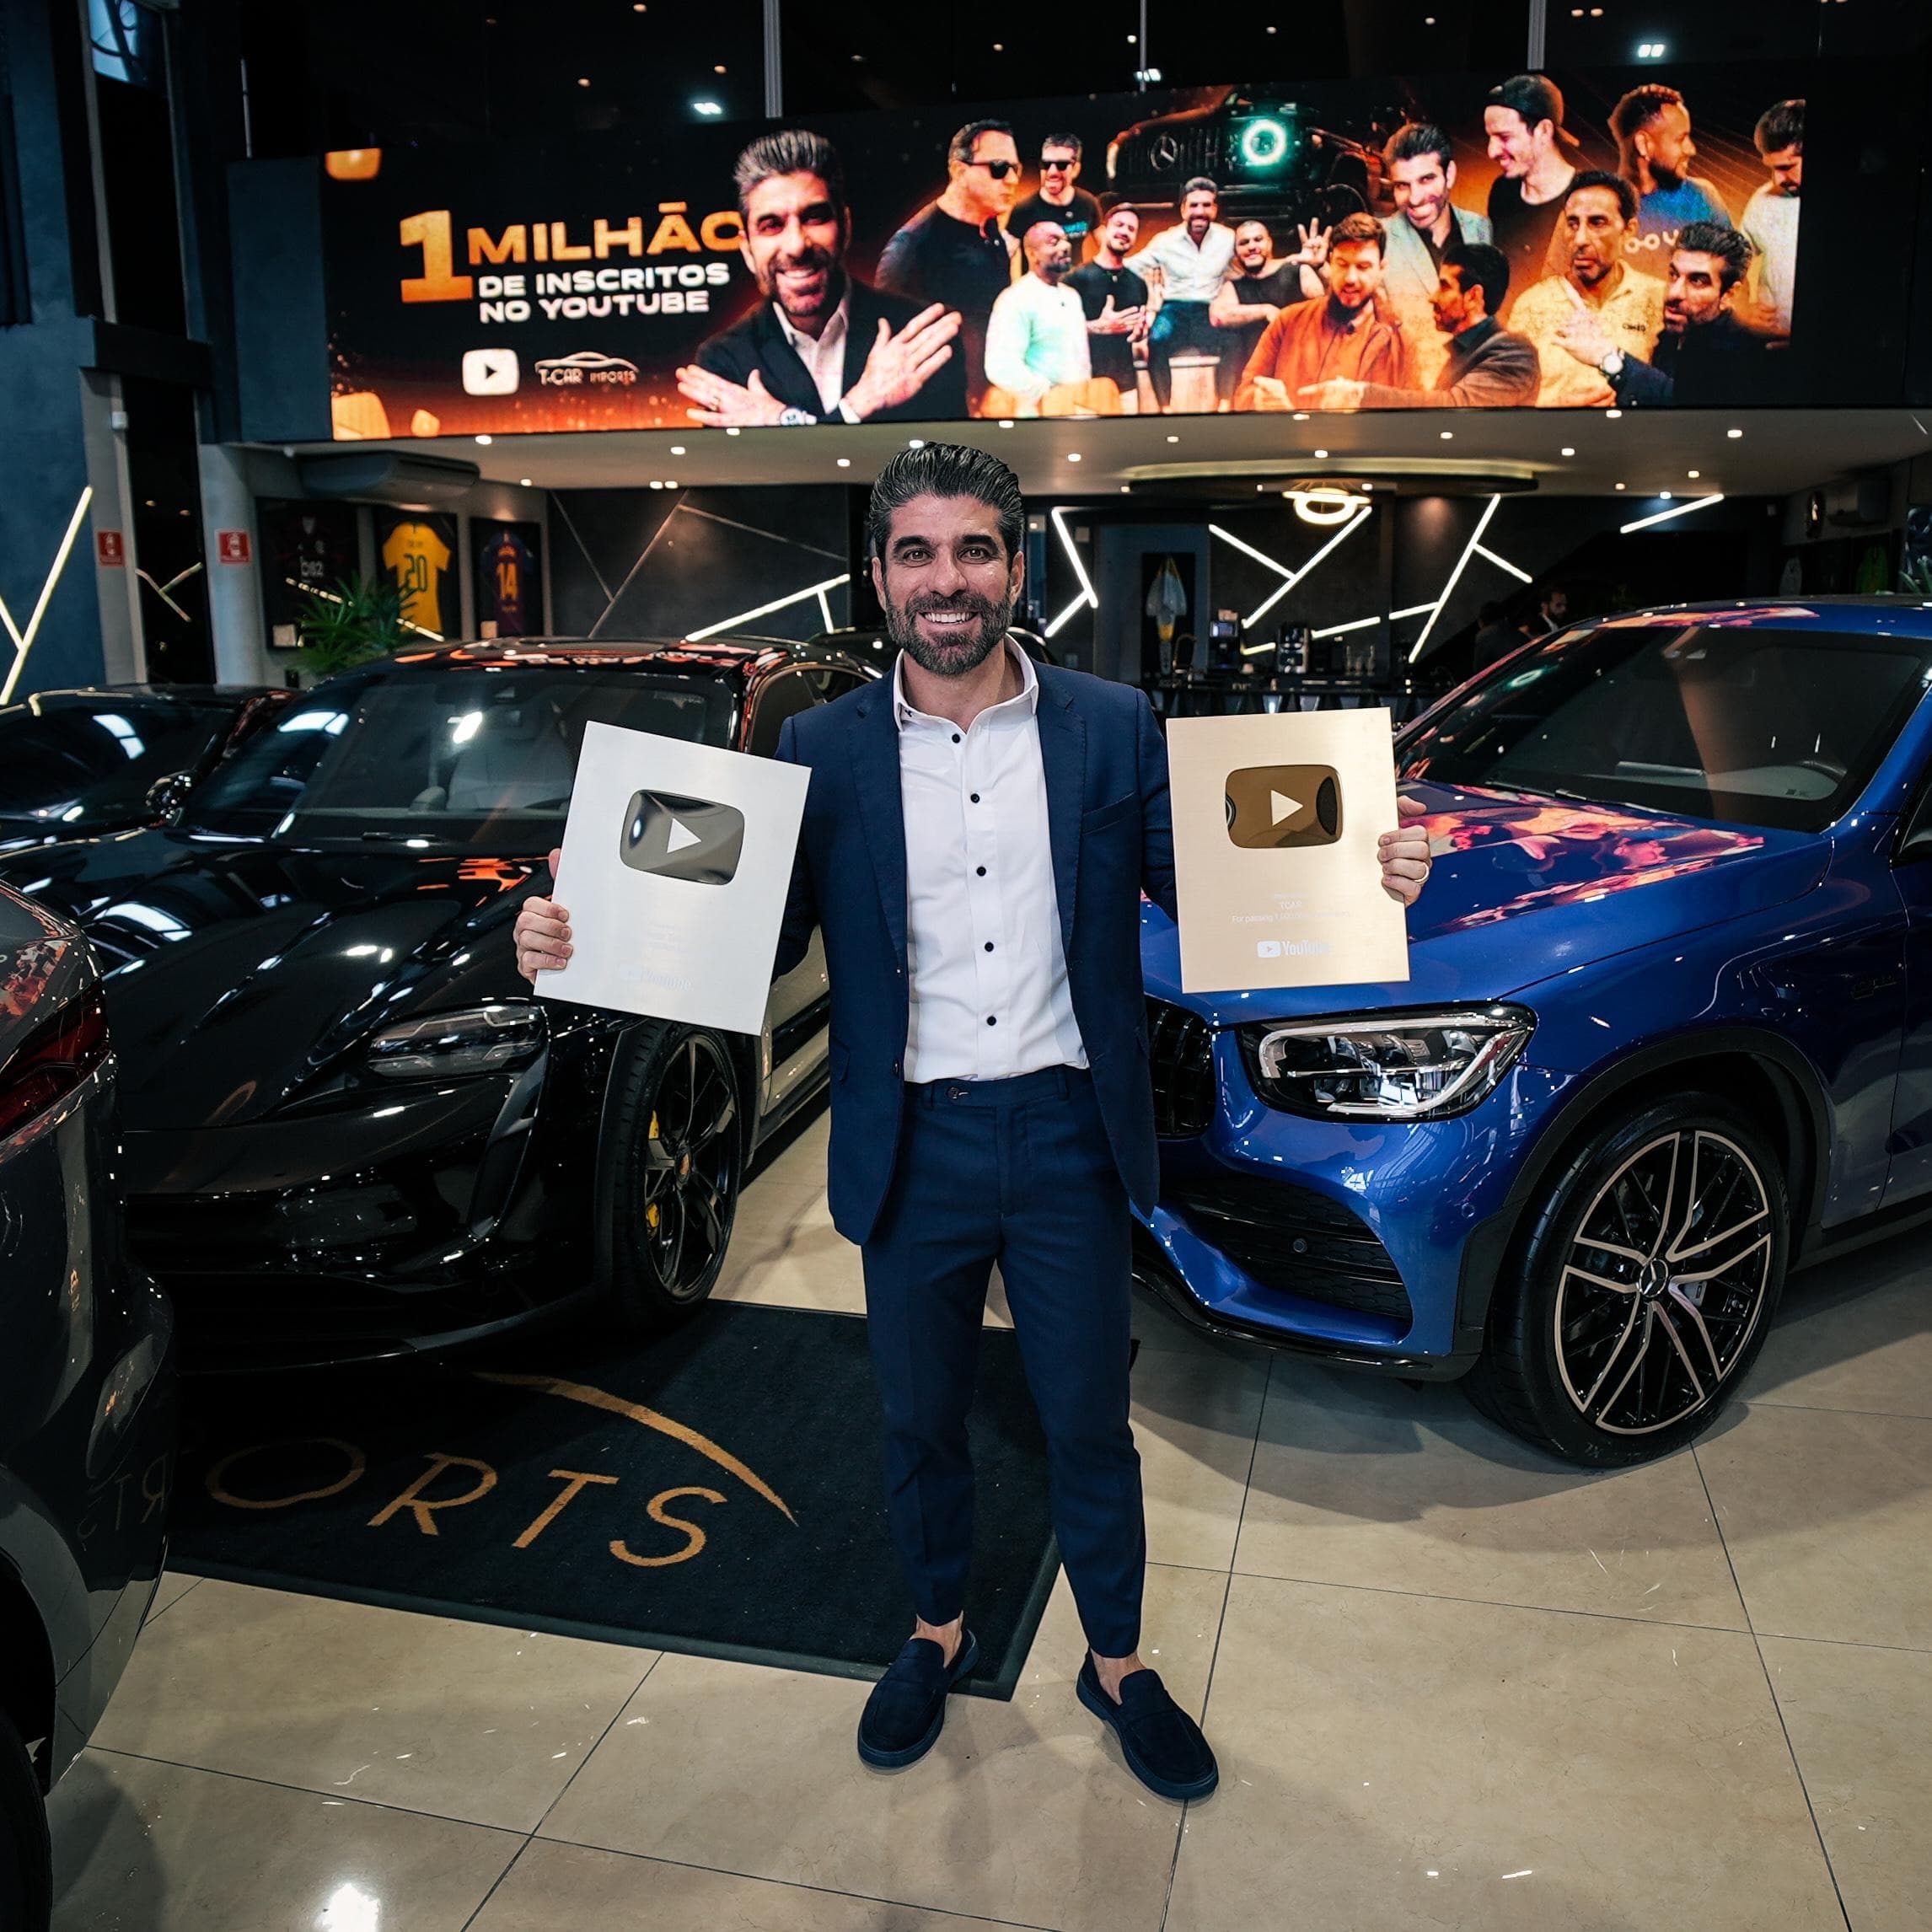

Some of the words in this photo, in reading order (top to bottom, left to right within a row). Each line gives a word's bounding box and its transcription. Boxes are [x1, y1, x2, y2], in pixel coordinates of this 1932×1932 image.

[400, 209, 474, 303] 1
[478, 274, 526, 298] DE
[536, 262, 730, 295] INSCRITOS
[480, 299, 531, 325] NO
[538, 290, 710, 321] YOUTUBE
[403, 553, 427, 593] 20
[496, 562, 518, 602] 14
[1281, 939, 1329, 956] YouTub
[205, 1437, 727, 1567] ORTS
